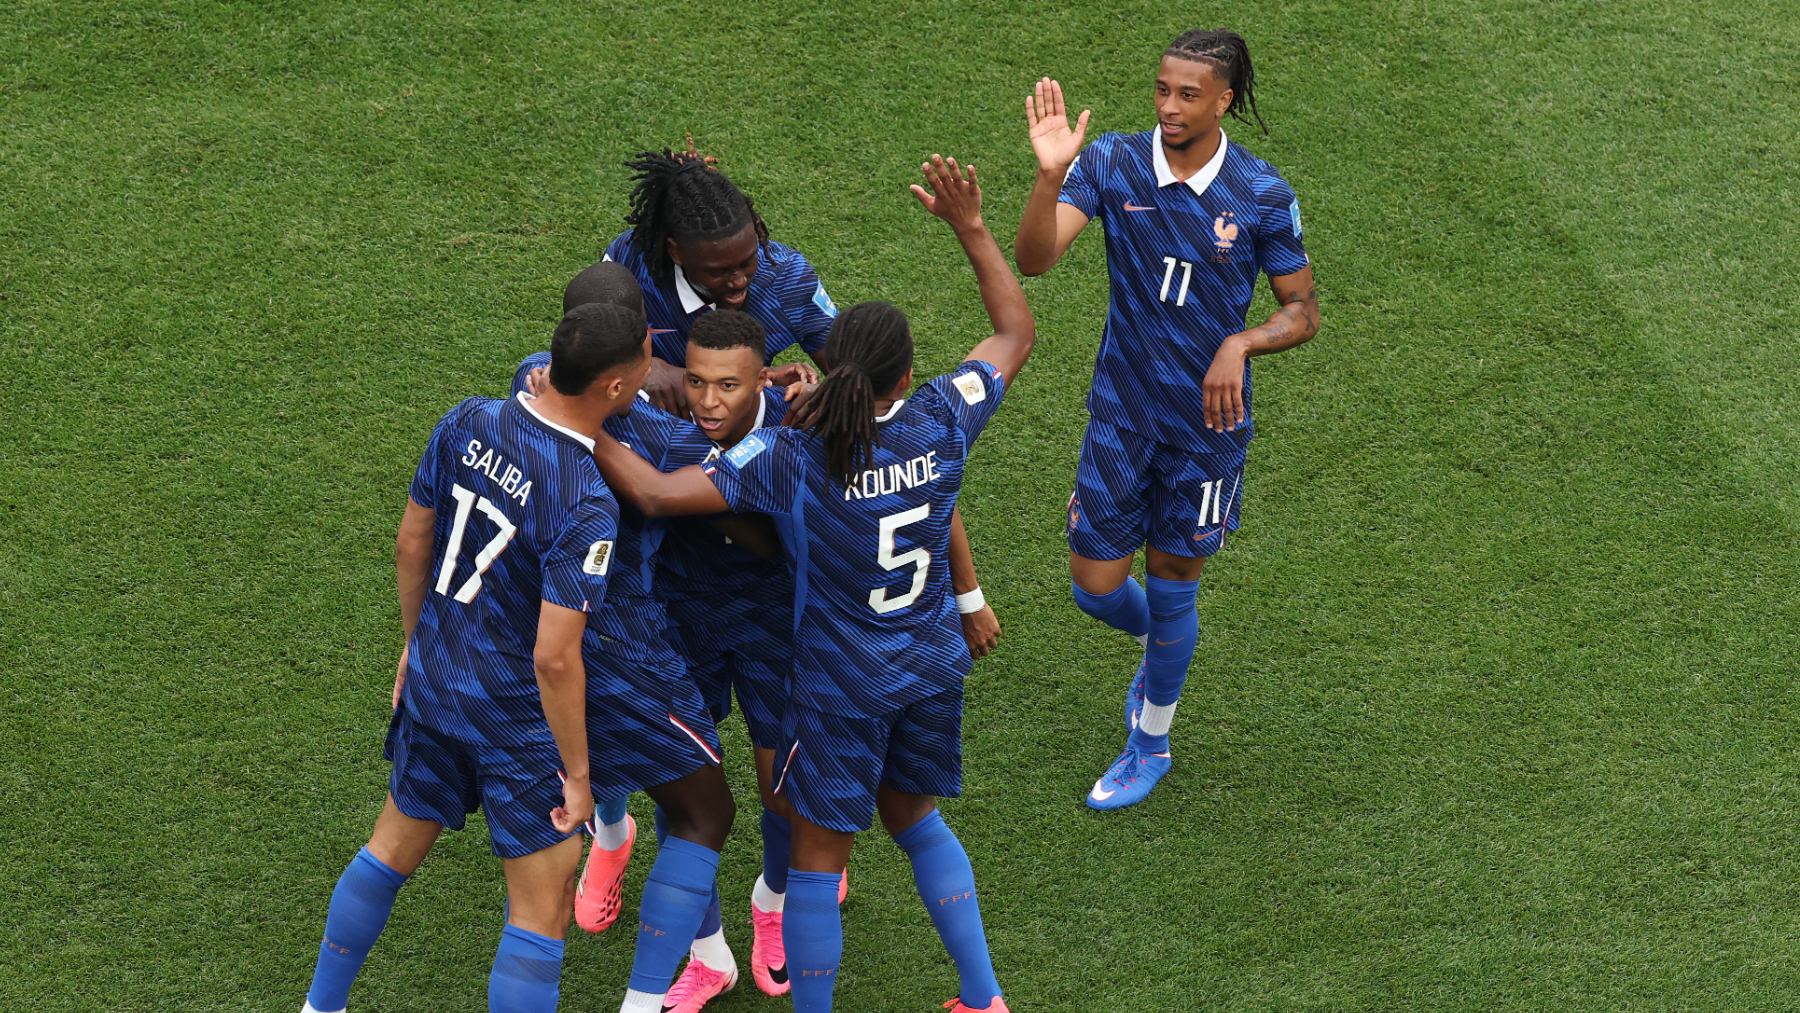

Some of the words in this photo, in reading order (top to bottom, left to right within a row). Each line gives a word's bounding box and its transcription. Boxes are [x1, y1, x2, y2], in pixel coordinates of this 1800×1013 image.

[1159, 256, 1193, 307] 11
[462, 439, 533, 507] SALIBA
[1197, 477, 1224, 527] 11
[435, 482, 517, 605] 17
[868, 502, 931, 614] 5
[938, 891, 972, 907] FFF
[802, 968, 834, 977] FFF
